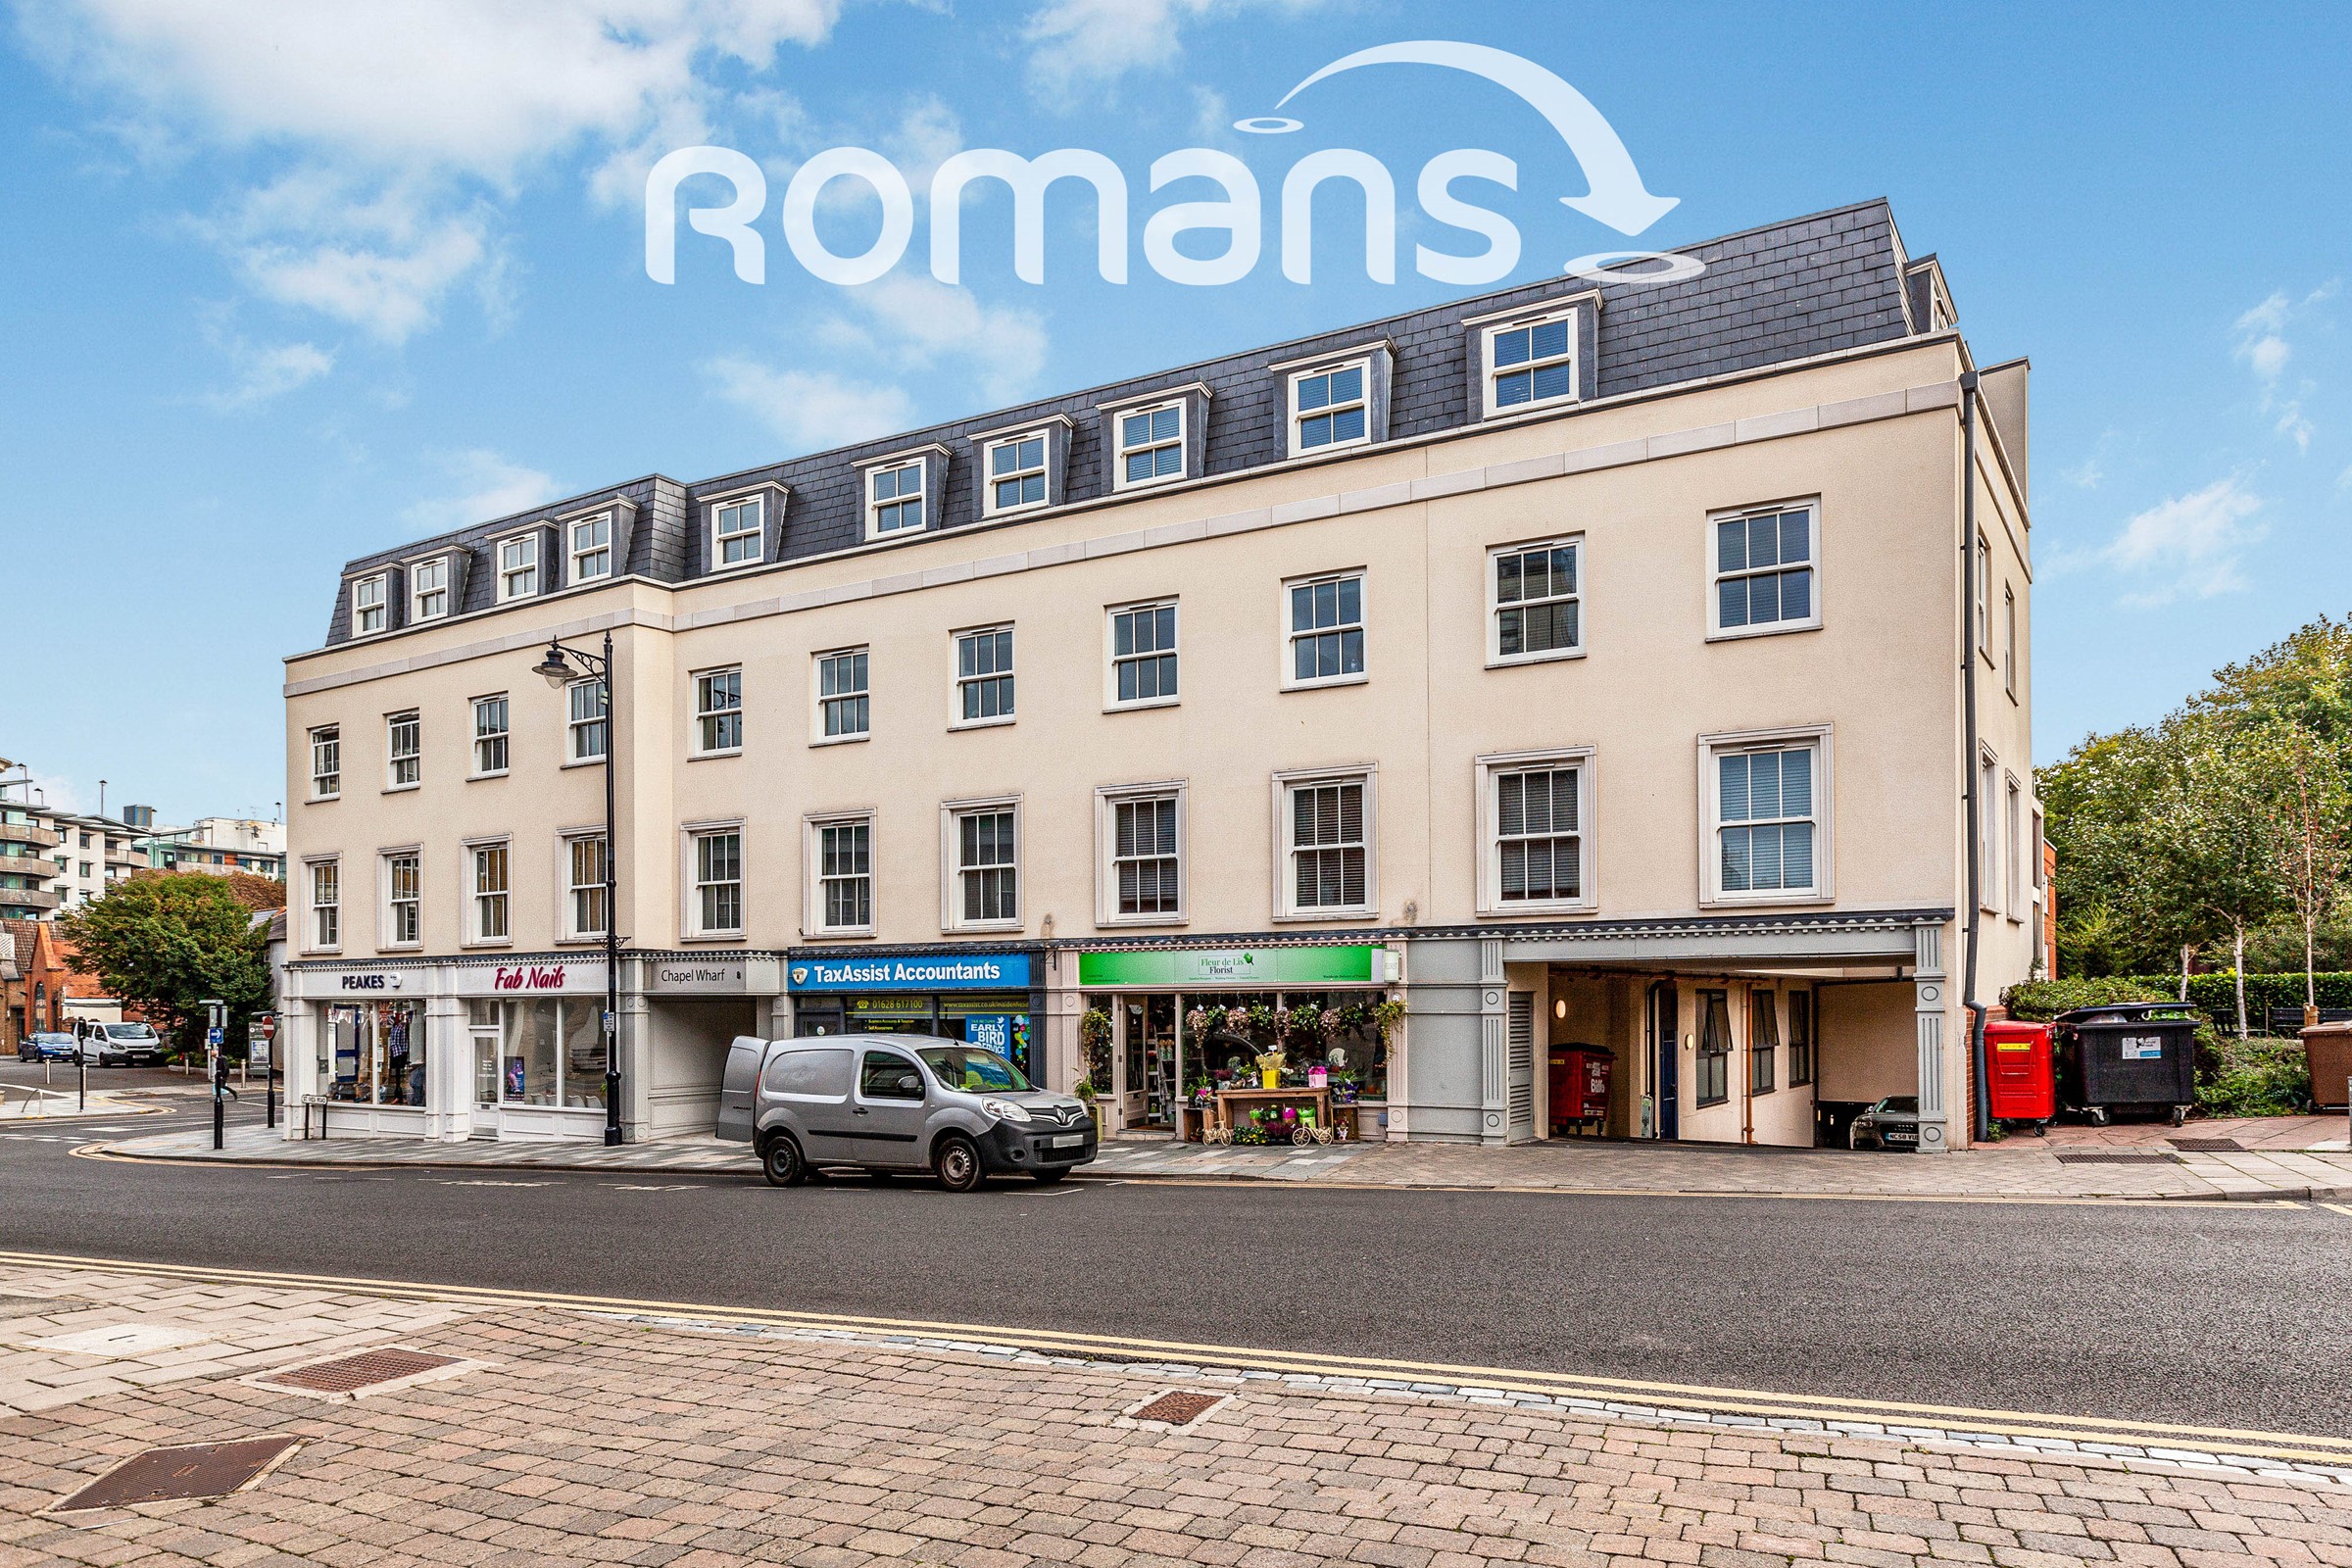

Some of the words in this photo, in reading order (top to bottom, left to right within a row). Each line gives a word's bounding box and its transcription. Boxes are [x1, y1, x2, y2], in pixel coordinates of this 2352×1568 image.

[1200, 957, 1221, 966] Fleur
[1221, 957, 1232, 966] de
[1233, 956, 1245, 966] Lis
[494, 966, 523, 990] Fab
[524, 965, 566, 989] Nails
[661, 968, 694, 985] Chapel
[695, 967, 726, 982] Wharf
[813, 963, 891, 983] TaxAssist
[893, 960, 1001, 981] Accountants
[1209, 965, 1234, 974] Florist
[342, 974, 385, 990] PEAKES
[872, 1000, 895, 1009] 01628
[970, 1023, 1004, 1032] EARLY
[977, 1031, 1005, 1047] BIRD
